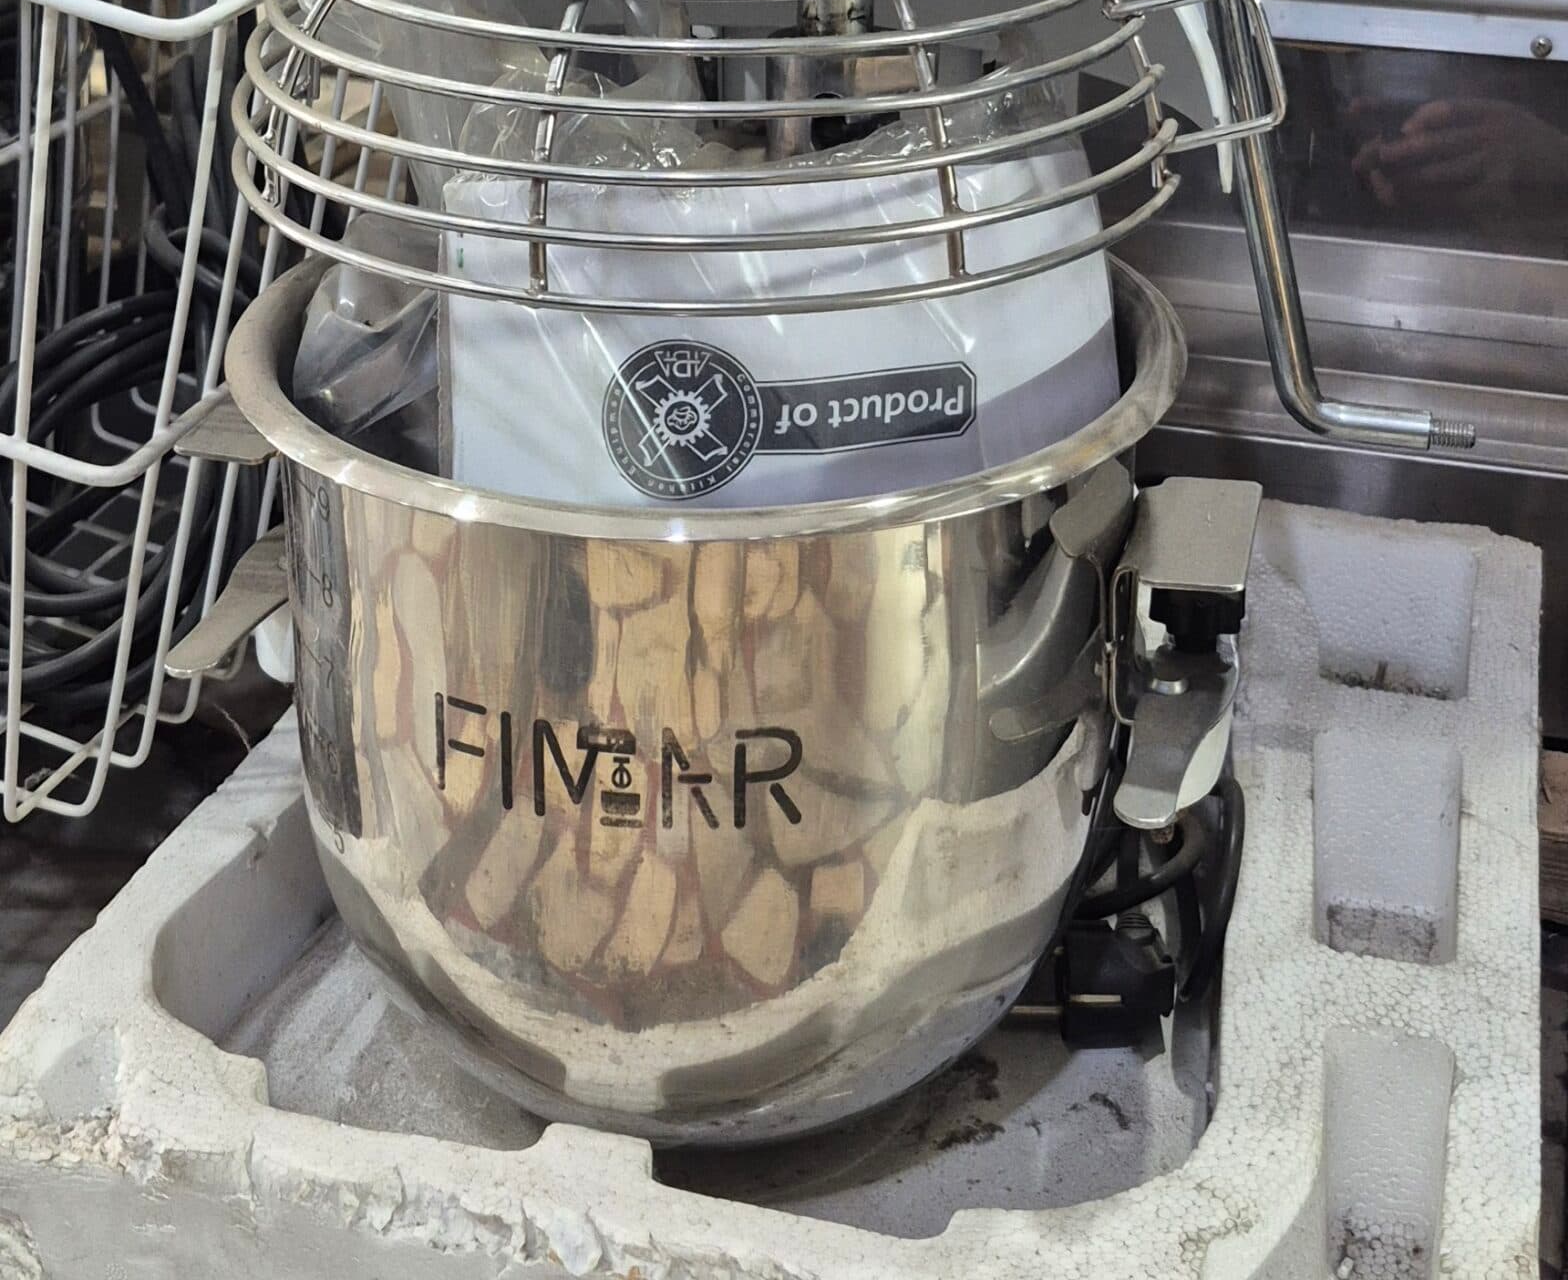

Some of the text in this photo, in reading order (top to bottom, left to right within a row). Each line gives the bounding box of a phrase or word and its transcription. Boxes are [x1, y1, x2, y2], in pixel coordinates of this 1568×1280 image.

[774, 384, 965, 435] Product of
[317, 486, 330, 522] 9
[322, 573, 334, 608] 8
[323, 655, 335, 689] 7
[435, 692, 803, 829] FIMAR
